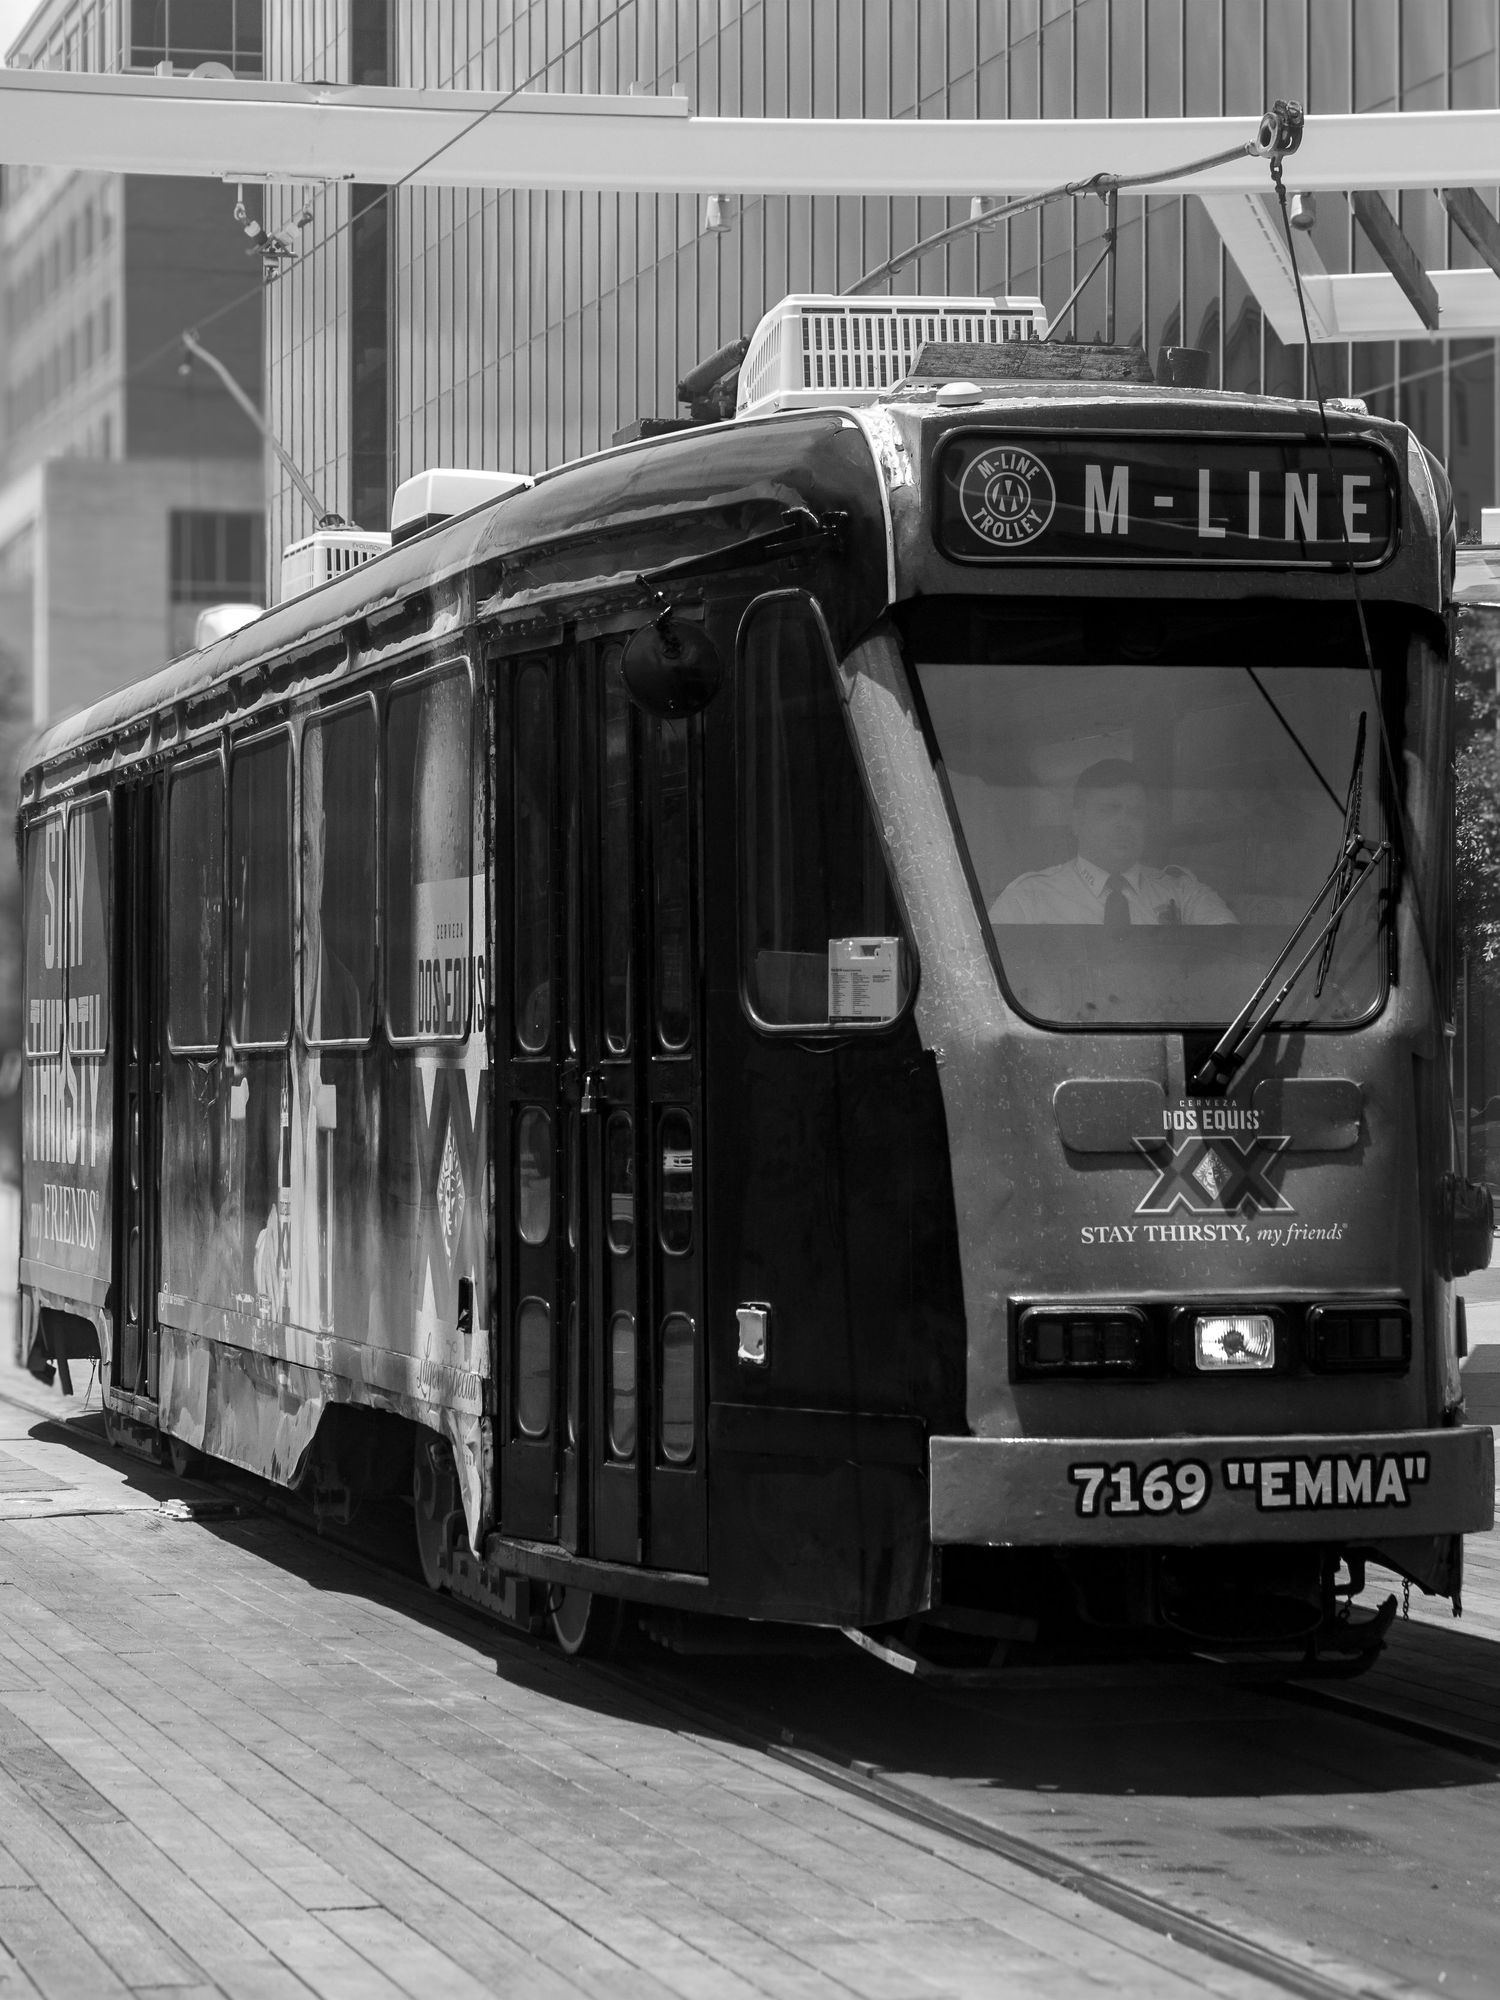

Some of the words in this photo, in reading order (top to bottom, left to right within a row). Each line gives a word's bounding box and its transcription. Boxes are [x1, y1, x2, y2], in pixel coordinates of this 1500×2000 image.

[977, 453, 1040, 481] M-LINE
[972, 507, 1043, 540] TROLLEY
[436, 922, 463, 940] CERVEZA
[418, 958, 441, 1034] DOS
[444, 955, 485, 1034] EQUIS
[30, 994, 101, 1168] THIRSTY
[1179, 1099, 1237, 1108] CERVEZA
[1162, 1109, 1198, 1131] DOS
[1202, 1109, 1260, 1131] EQUIS
[31, 1202, 42, 1259] my
[44, 1183, 97, 1251] FRIENDS
[1080, 1225, 1139, 1245] STAY
[1143, 1223, 1251, 1244] THIRSTY,
[1256, 1229, 1282, 1247] my
[1072, 1462, 1208, 1514] 7169
[1226, 1456, 1427, 1508] "EMMA"
